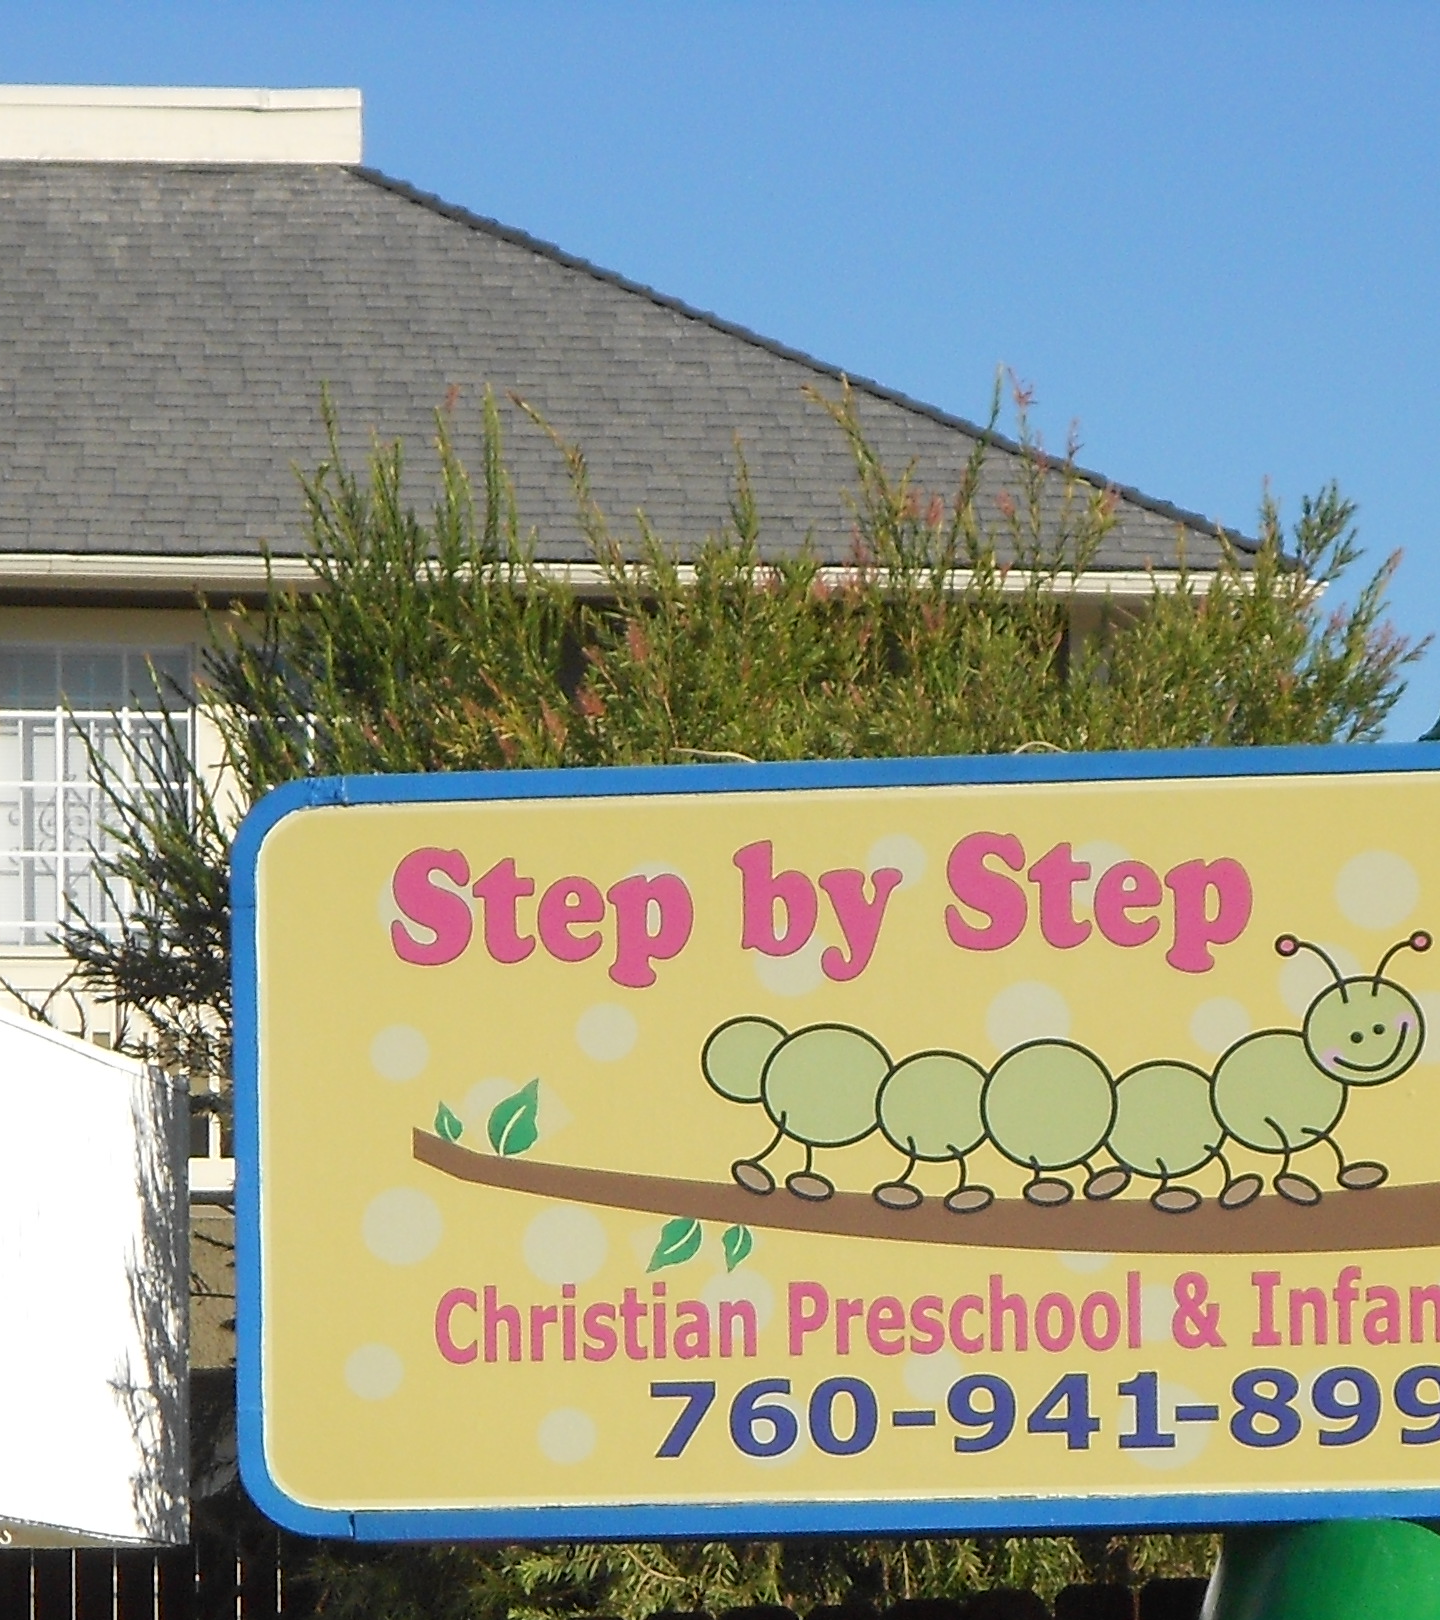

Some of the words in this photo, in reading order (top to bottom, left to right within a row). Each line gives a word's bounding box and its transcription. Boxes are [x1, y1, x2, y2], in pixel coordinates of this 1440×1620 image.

[391, 846, 694, 988] Step
[733, 840, 903, 981] by
[945, 831, 1254, 973] Step
[435, 1282, 759, 1364] Christian
[787, 1272, 1142, 1357] Preschool
[1171, 1270, 1227, 1349] &
